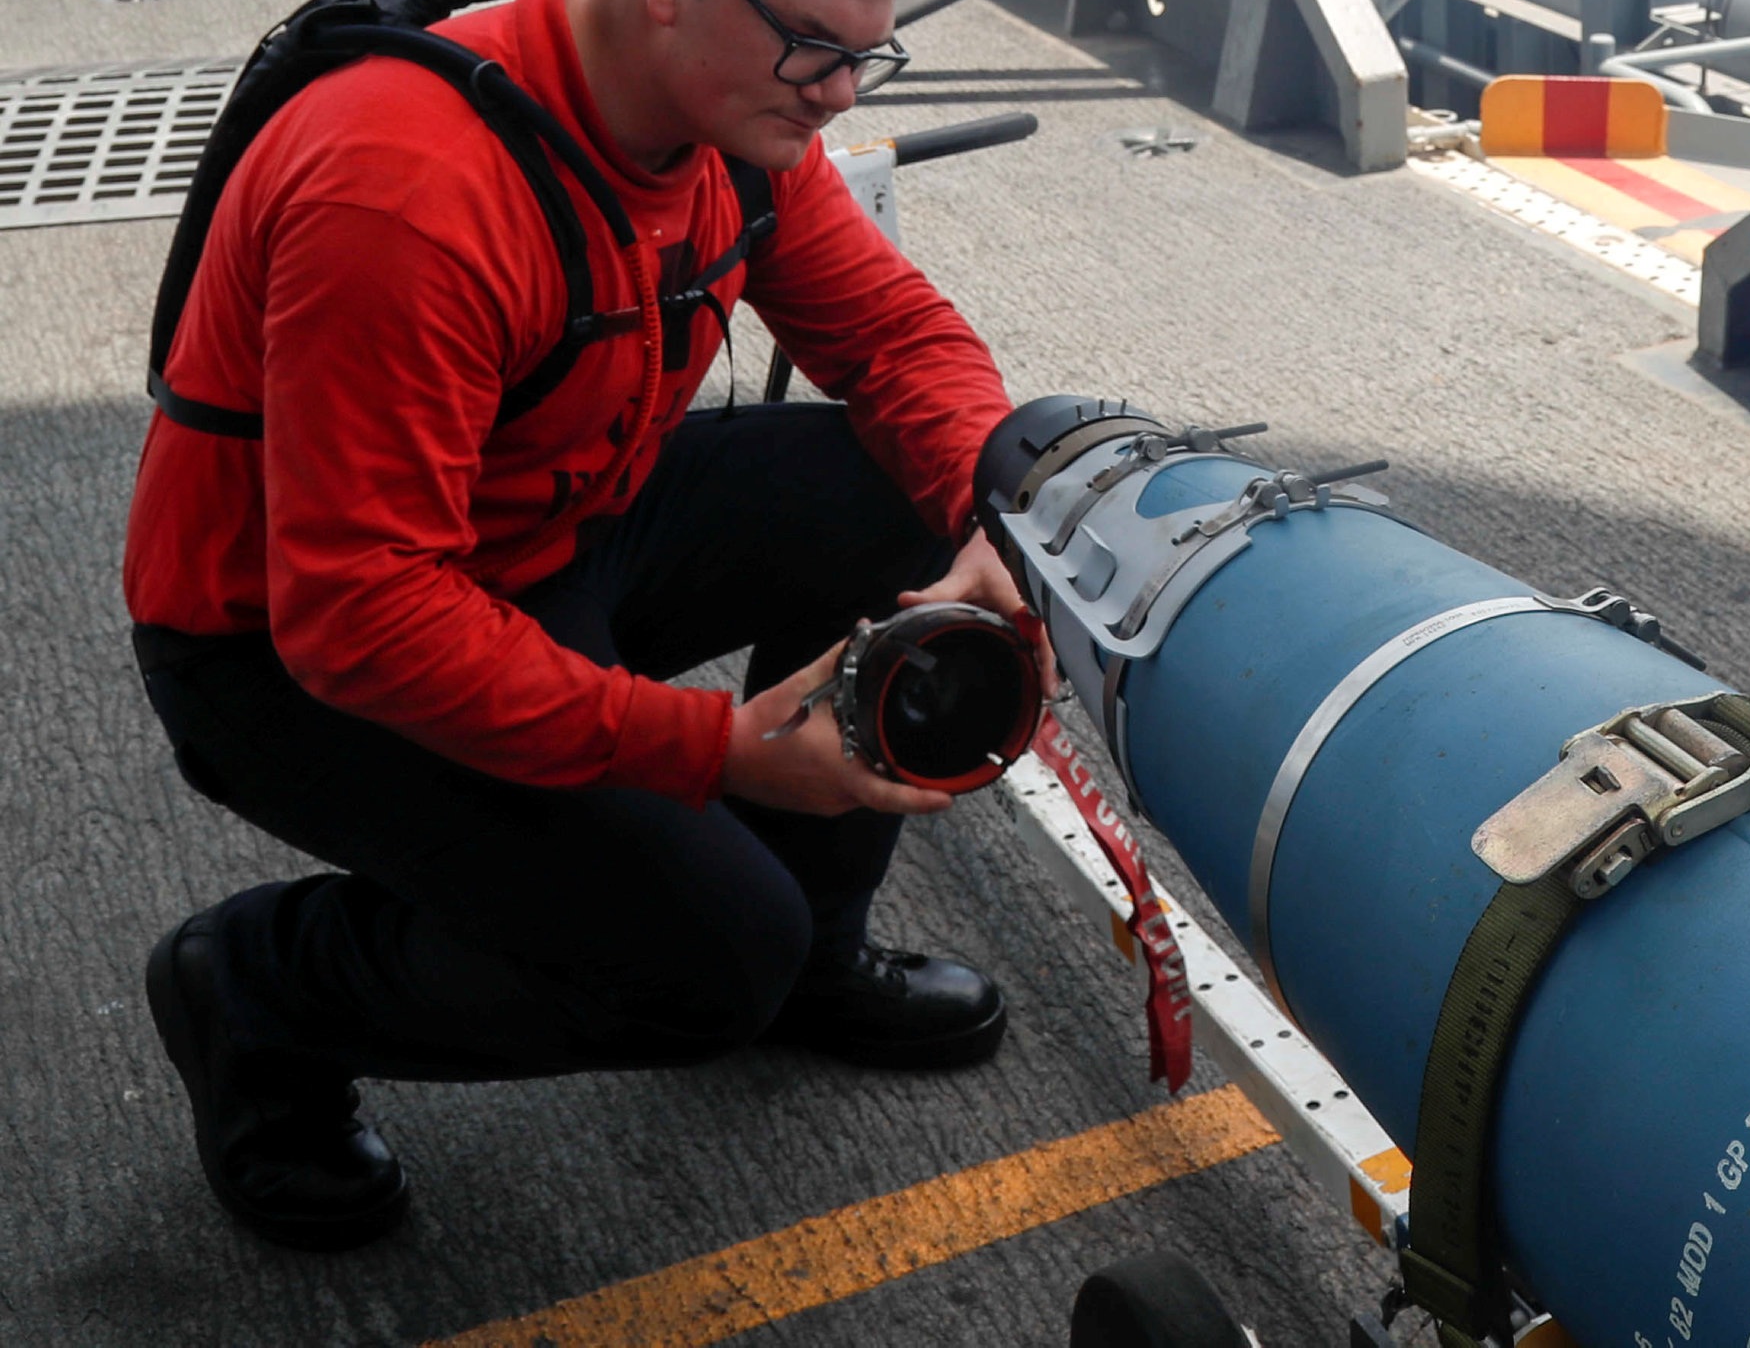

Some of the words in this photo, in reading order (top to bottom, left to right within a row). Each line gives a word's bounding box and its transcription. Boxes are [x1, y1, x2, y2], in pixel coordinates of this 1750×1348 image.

[1716, 1139, 1749, 1190] GP
[1703, 1191, 1727, 1215] 1
[1676, 1221, 1714, 1297] MOD
[1669, 1296, 1694, 1341] 82
